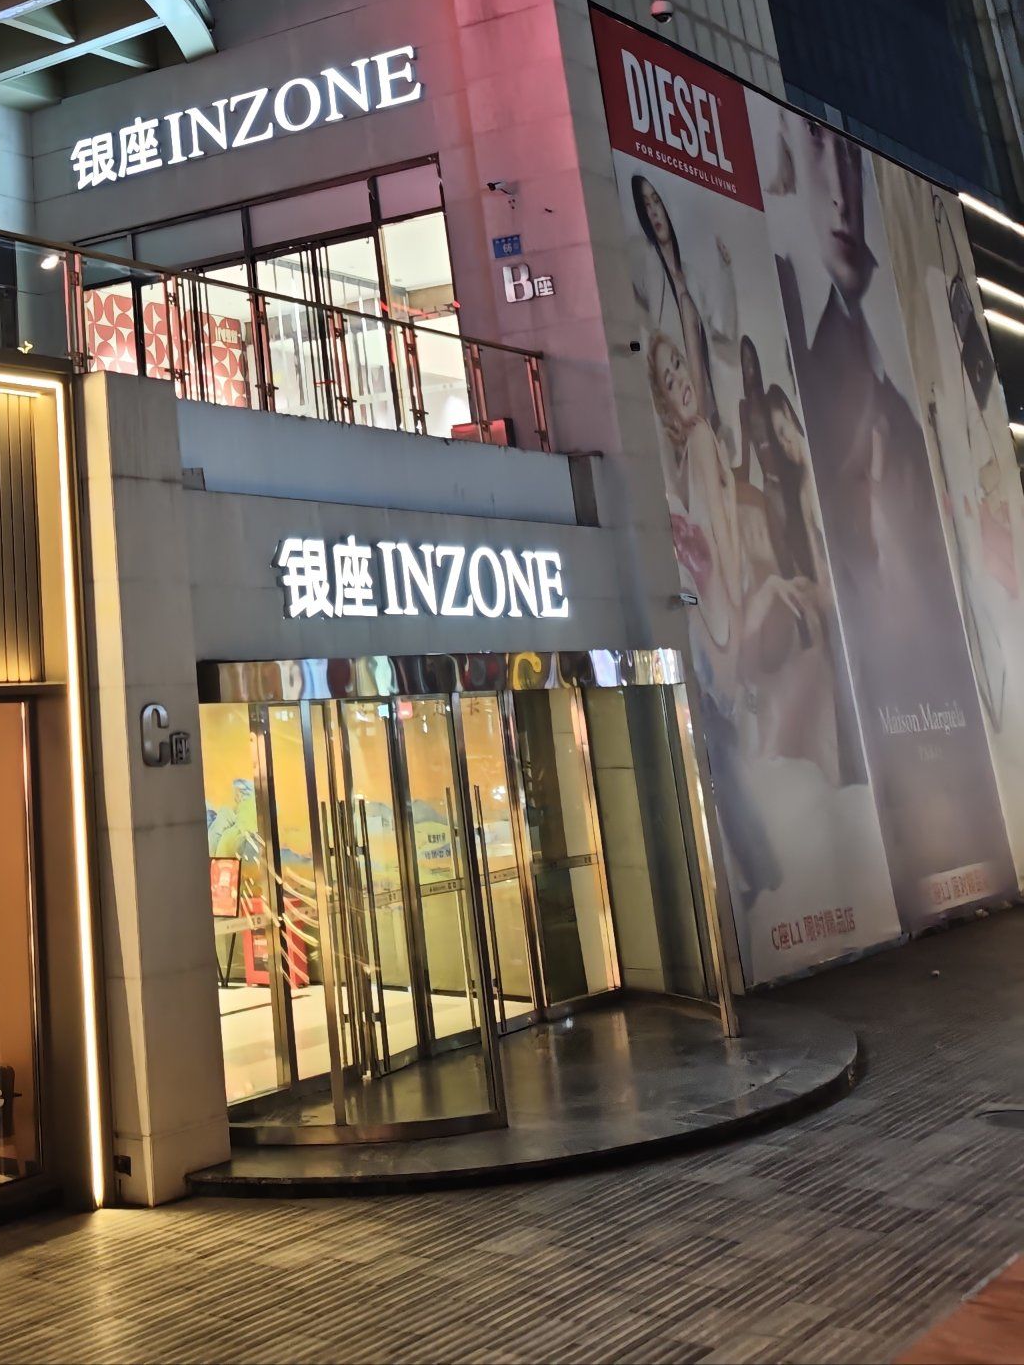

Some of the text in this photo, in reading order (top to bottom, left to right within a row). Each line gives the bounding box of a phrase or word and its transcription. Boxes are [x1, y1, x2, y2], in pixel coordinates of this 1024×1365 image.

[621, 48, 734, 174] DIESEL
[635, 141, 737, 194] FOR SUCCESSFUL LIVING
[502, 263, 554, 303] B座
[140, 703, 191, 767] C座
